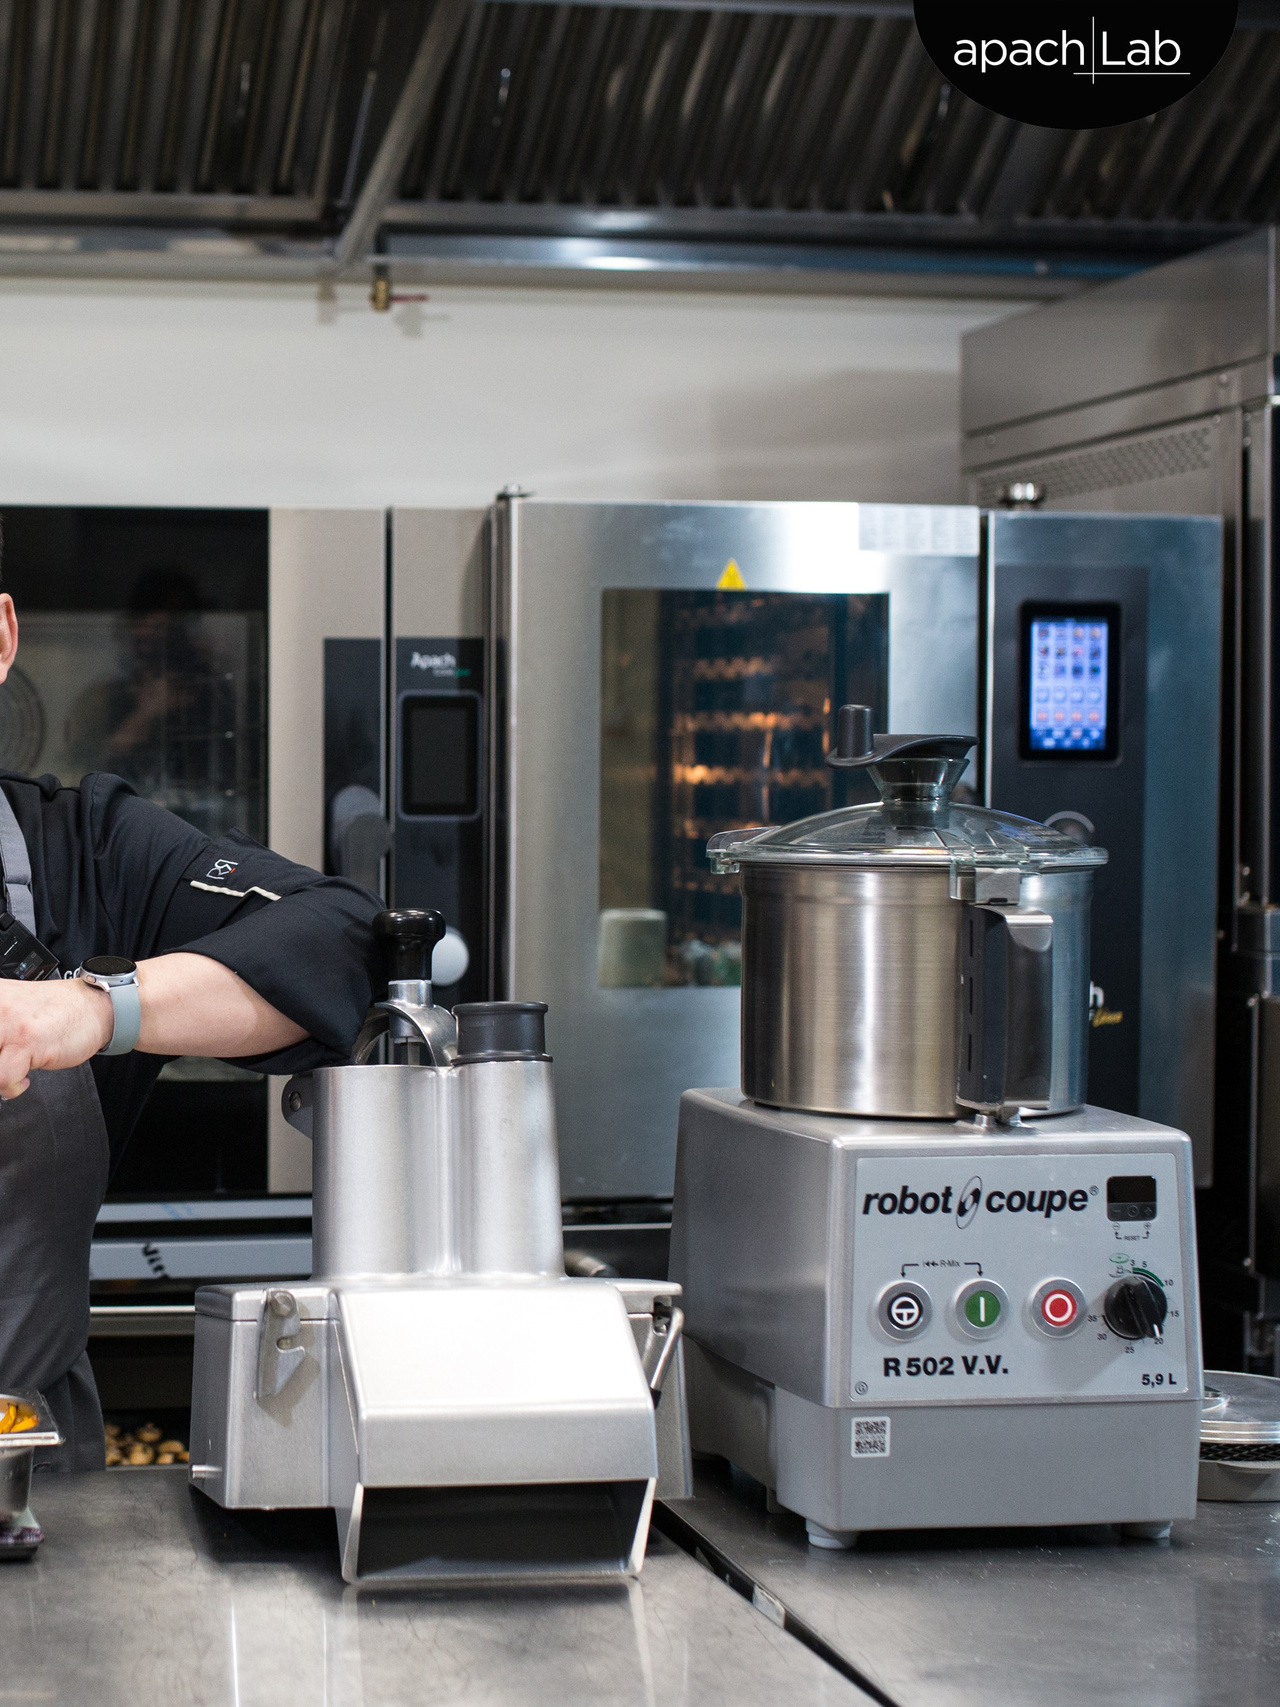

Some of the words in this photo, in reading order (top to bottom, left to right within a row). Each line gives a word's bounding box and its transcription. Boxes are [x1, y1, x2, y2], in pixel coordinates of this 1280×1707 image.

[862, 1184, 954, 1216] robot
[1164, 1279, 1174, 1287] 10
[1170, 1310, 1180, 1318] 15
[882, 1357, 902, 1378] R
[905, 1356, 956, 1377] 502
[960, 1354, 1010, 1376] V.V.
[1140, 1374, 1165, 1389] 5,9
[1168, 1373, 1178, 1386] L
